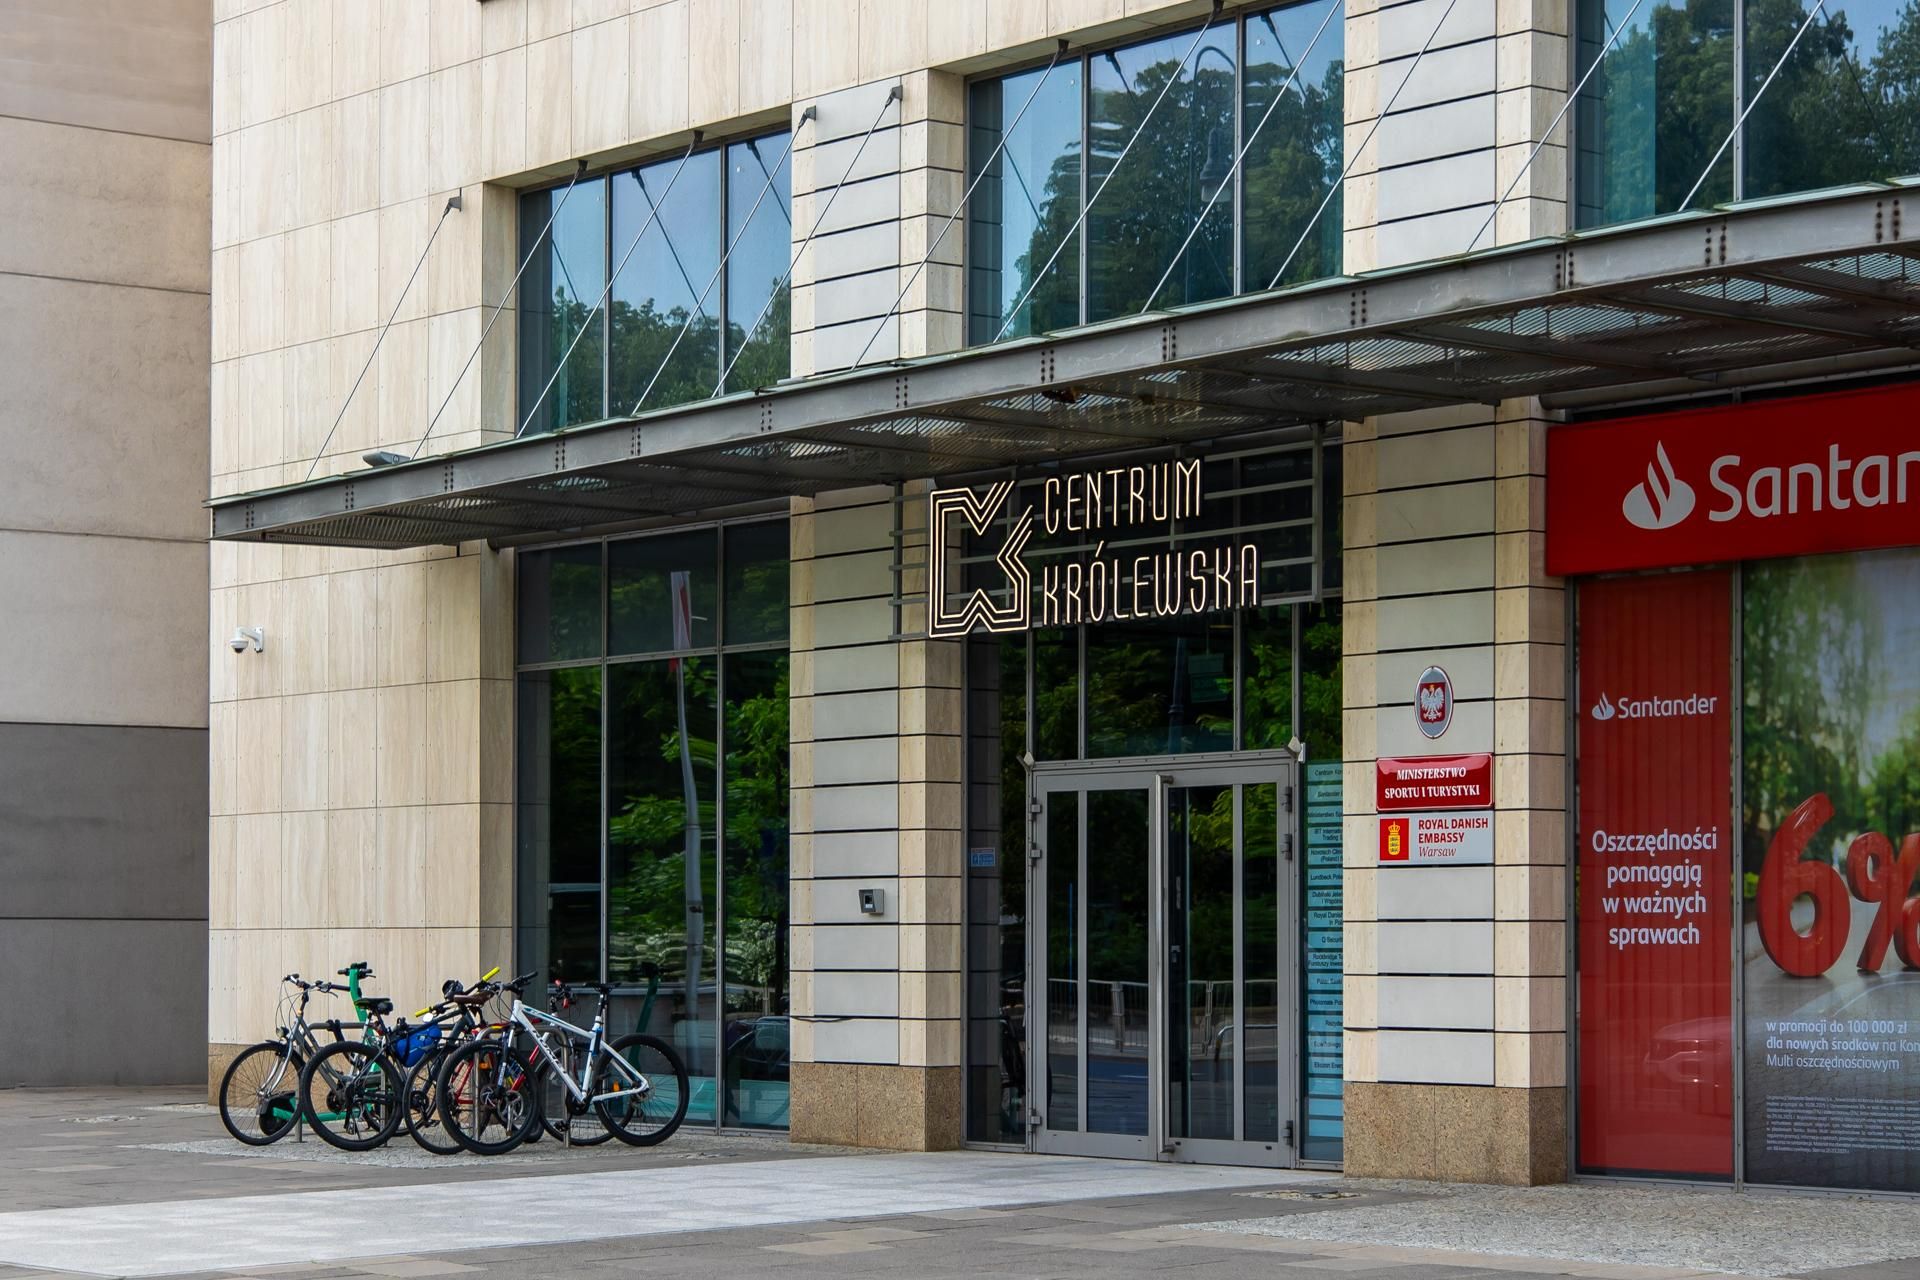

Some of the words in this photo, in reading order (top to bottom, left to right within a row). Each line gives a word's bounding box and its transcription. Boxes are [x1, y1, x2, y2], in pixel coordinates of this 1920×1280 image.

[1045, 459, 1201, 535] CENTRUM
[1043, 540, 1258, 626] KRÓLEWSKA
[1617, 693, 1718, 719] Santander
[1396, 767, 1467, 781] MINISTERSTWO
[1384, 787, 1420, 799] SPORTU
[1421, 786, 1426, 798] I
[1427, 785, 1480, 797] TURYSTYKI
[1418, 819, 1450, 830] ROYAL
[1451, 817, 1489, 829] DANISH
[1418, 832, 1465, 844] EMBASSY
[1592, 826, 1718, 856] Oszczędności
[1418, 846, 1457, 858] Warsaw
[1607, 859, 1702, 888] pomagają
[1602, 897, 1620, 914] w
[1624, 890, 1707, 919] ważnych
[1609, 922, 1700, 951] sprawach
[1766, 1021, 1777, 1032] w
[1779, 1019, 1827, 1035] promocji
[1829, 1020, 1844, 1033] do
[1848, 1021, 1869, 1034] 100
[1871, 1021, 1895, 1034] 000
[1896, 1021, 1908, 1034] zł
[1766, 1036, 1783, 1049] dla
[1785, 1037, 1829, 1054] nowych
[1831, 1037, 1879, 1051] środków
[1882, 1041, 1896, 1052] na
[1766, 1054, 1794, 1067] Multi
[1796, 1055, 1900, 1073] oszczędnościowym
